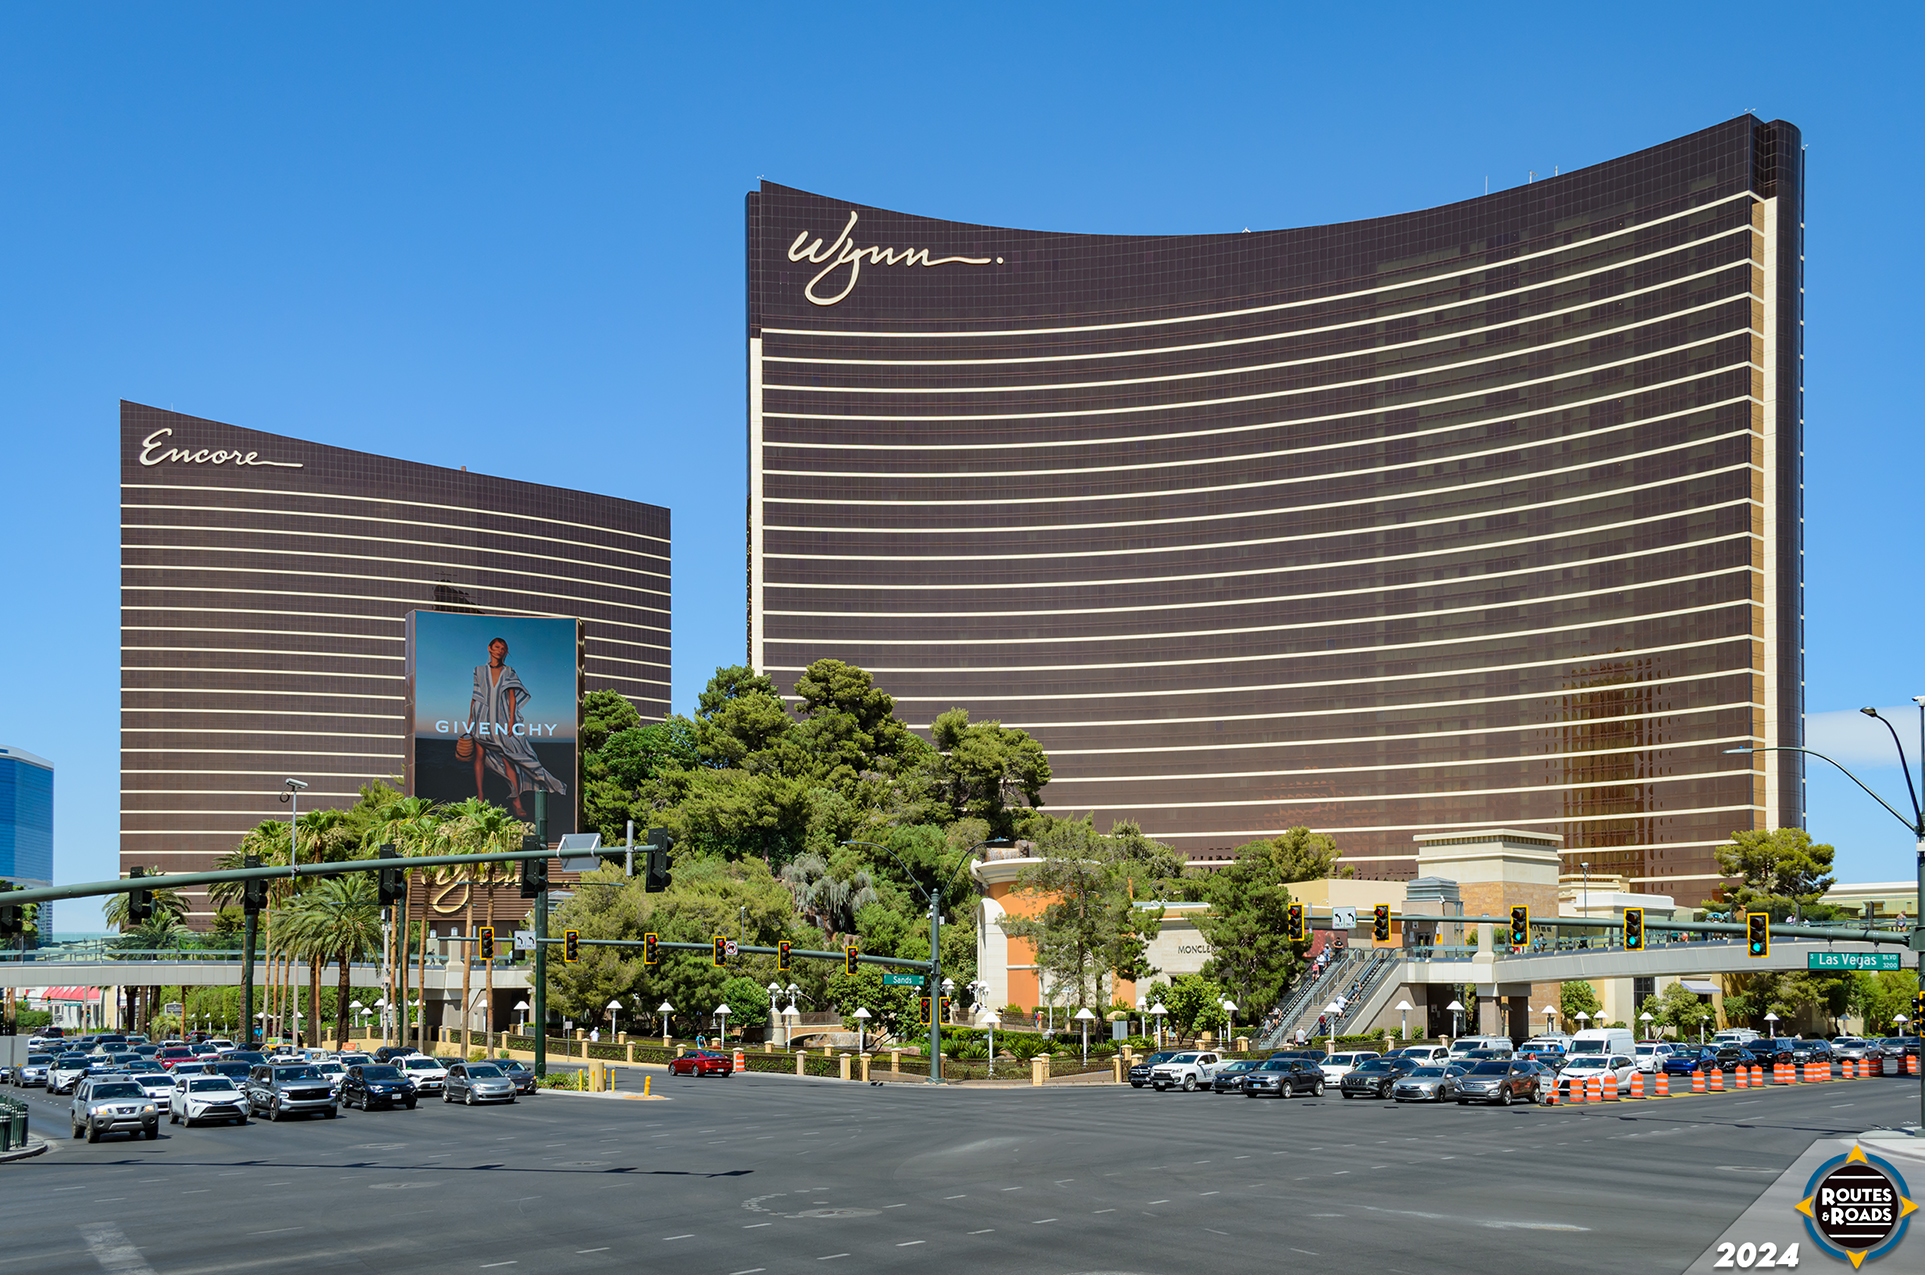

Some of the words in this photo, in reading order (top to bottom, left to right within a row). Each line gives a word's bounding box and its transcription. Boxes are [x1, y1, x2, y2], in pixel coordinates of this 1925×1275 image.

[139, 427, 304, 468] Encore
[435, 720, 558, 736] GIVENCHY
[1819, 953, 1838, 965] Las
[1841, 953, 1877, 968] Vegas
[893, 975, 912, 984] Sands
